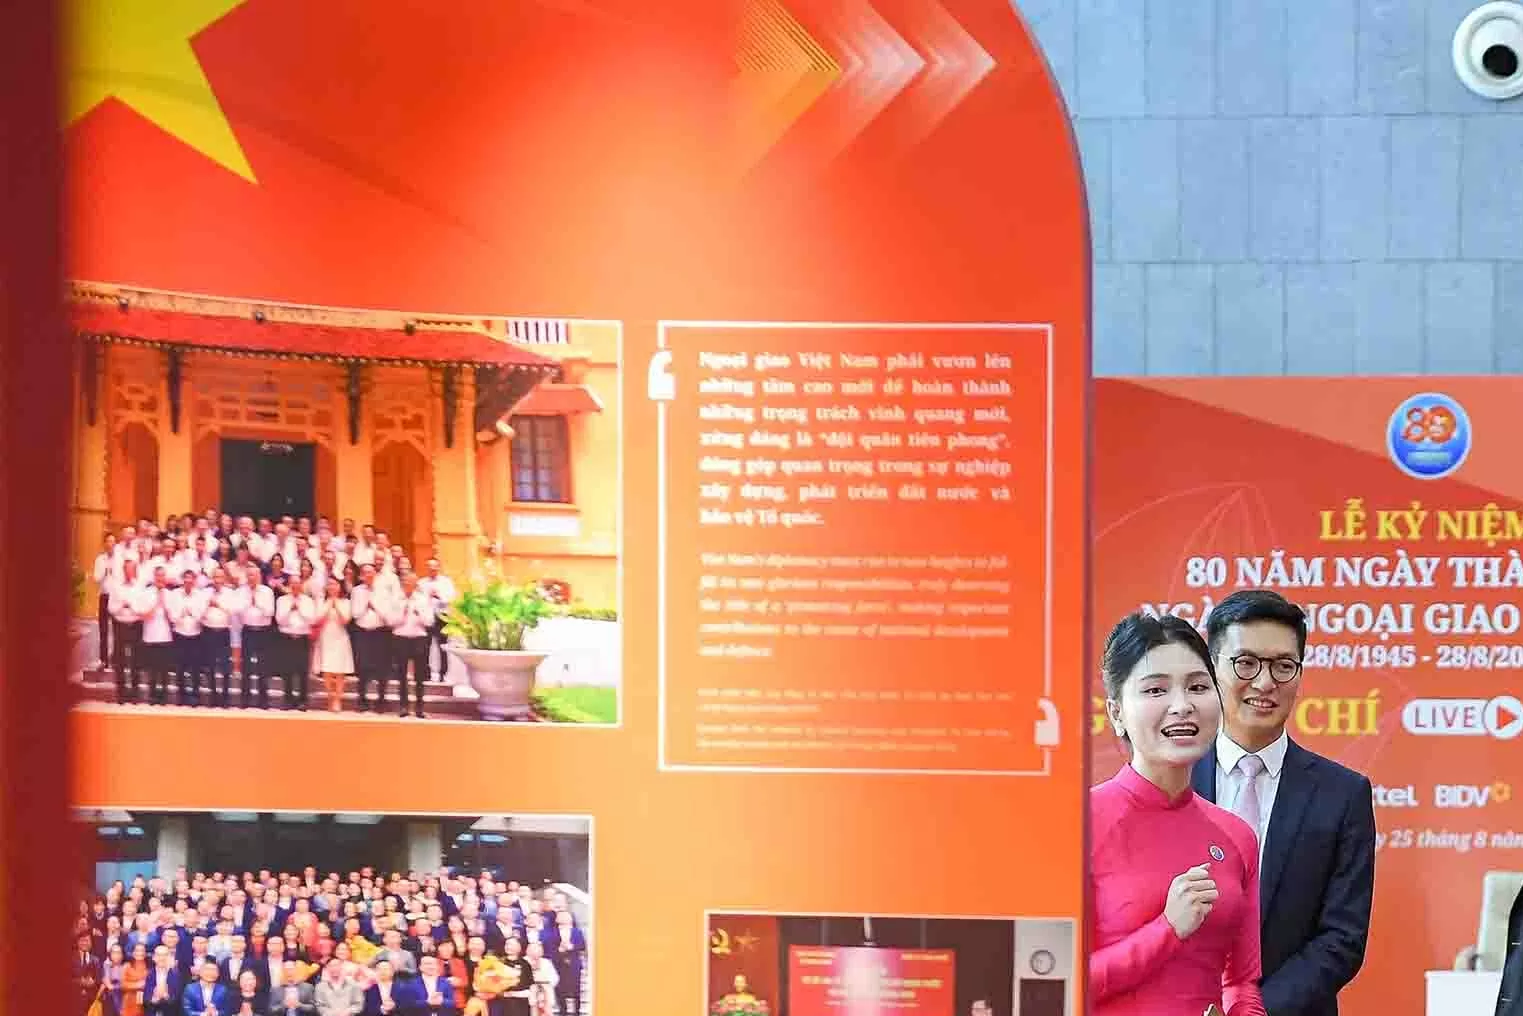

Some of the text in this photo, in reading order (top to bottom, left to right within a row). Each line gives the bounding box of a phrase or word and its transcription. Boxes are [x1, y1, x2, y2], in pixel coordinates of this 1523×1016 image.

[1319, 497, 1367, 541] LỄ
[1375, 500, 1428, 541] KỶ
[1186, 556, 1228, 587] 80
[1234, 550, 1325, 587] NĂM
[1333, 549, 1441, 587] NGÀY
[1424, 602, 1520, 635] GIAO
[1295, 687, 1381, 735] CHÍ
[1414, 705, 1476, 729] LIVE
[1434, 784, 1489, 808] BIDV
